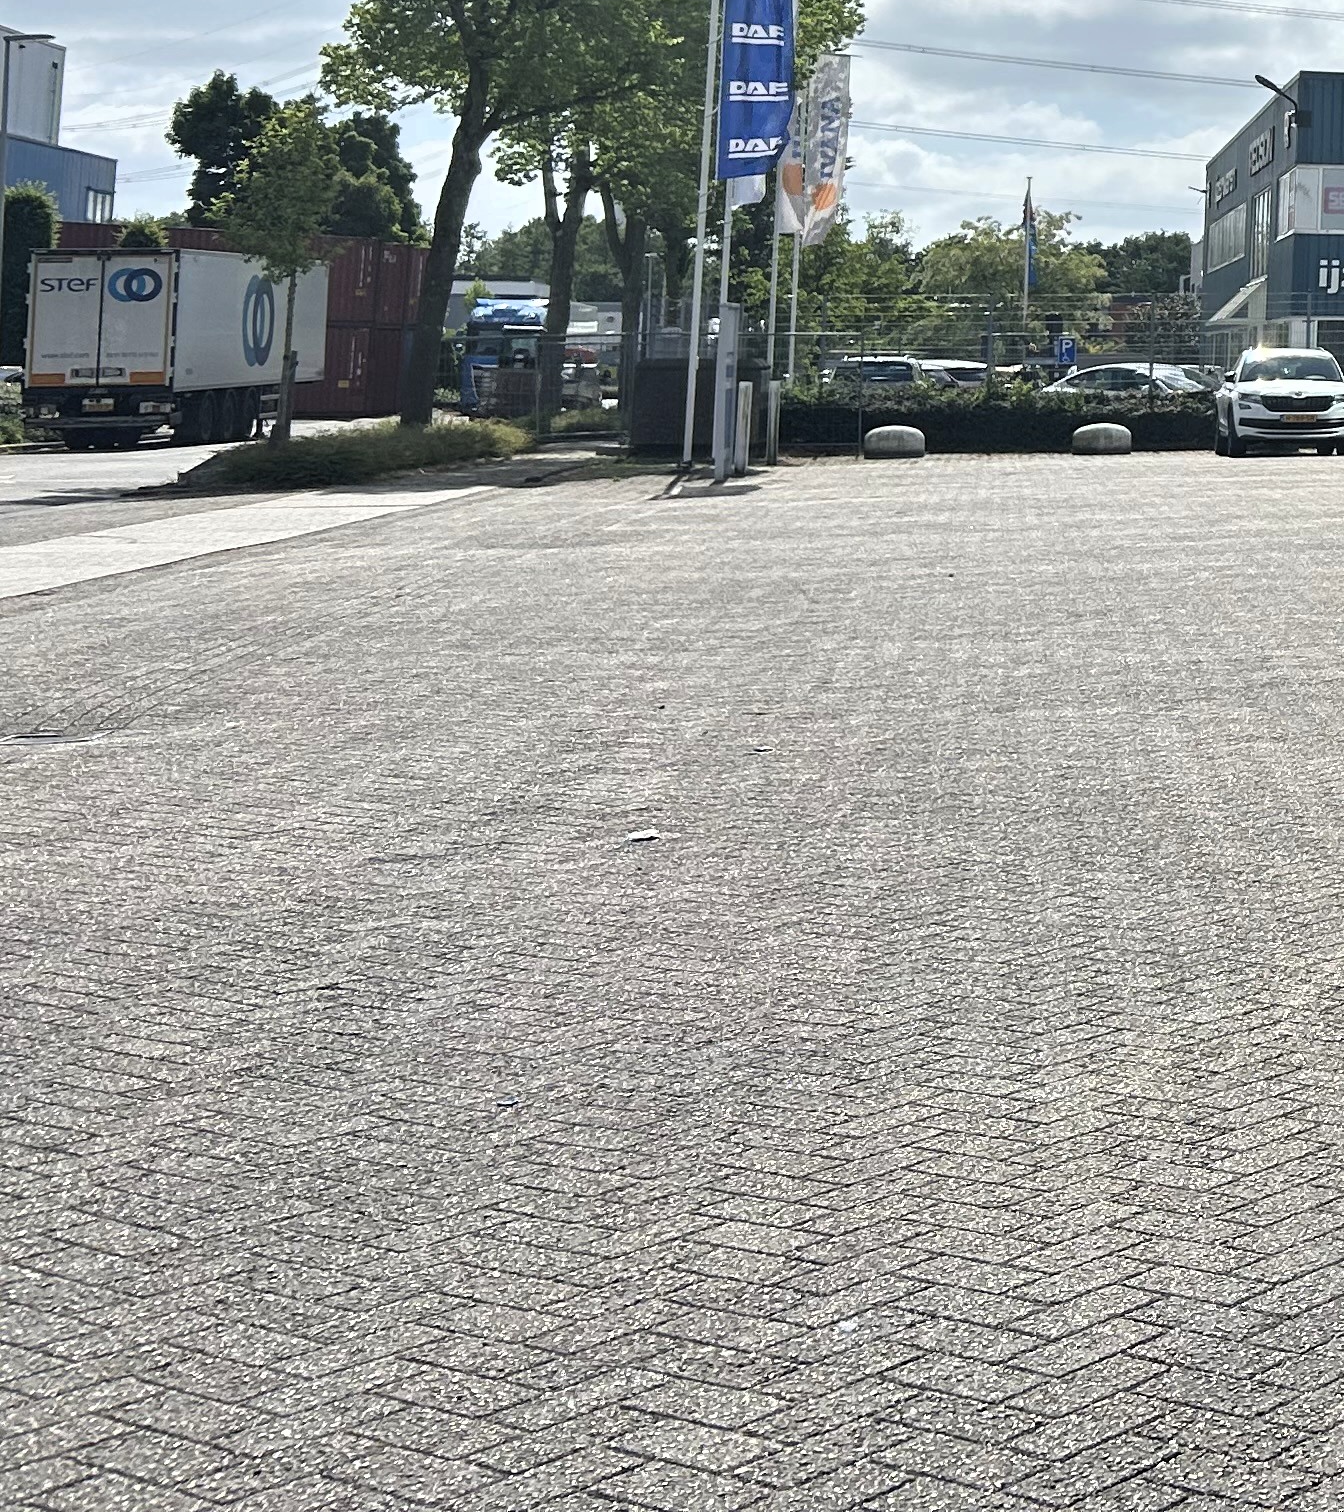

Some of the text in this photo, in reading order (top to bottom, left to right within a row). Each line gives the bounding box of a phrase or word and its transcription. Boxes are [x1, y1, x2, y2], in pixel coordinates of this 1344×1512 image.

[731, 22, 785, 38] DAF
[729, 80, 788, 96] DAF
[728, 137, 783, 153] DAF
[1062, 340, 1074, 354] P
